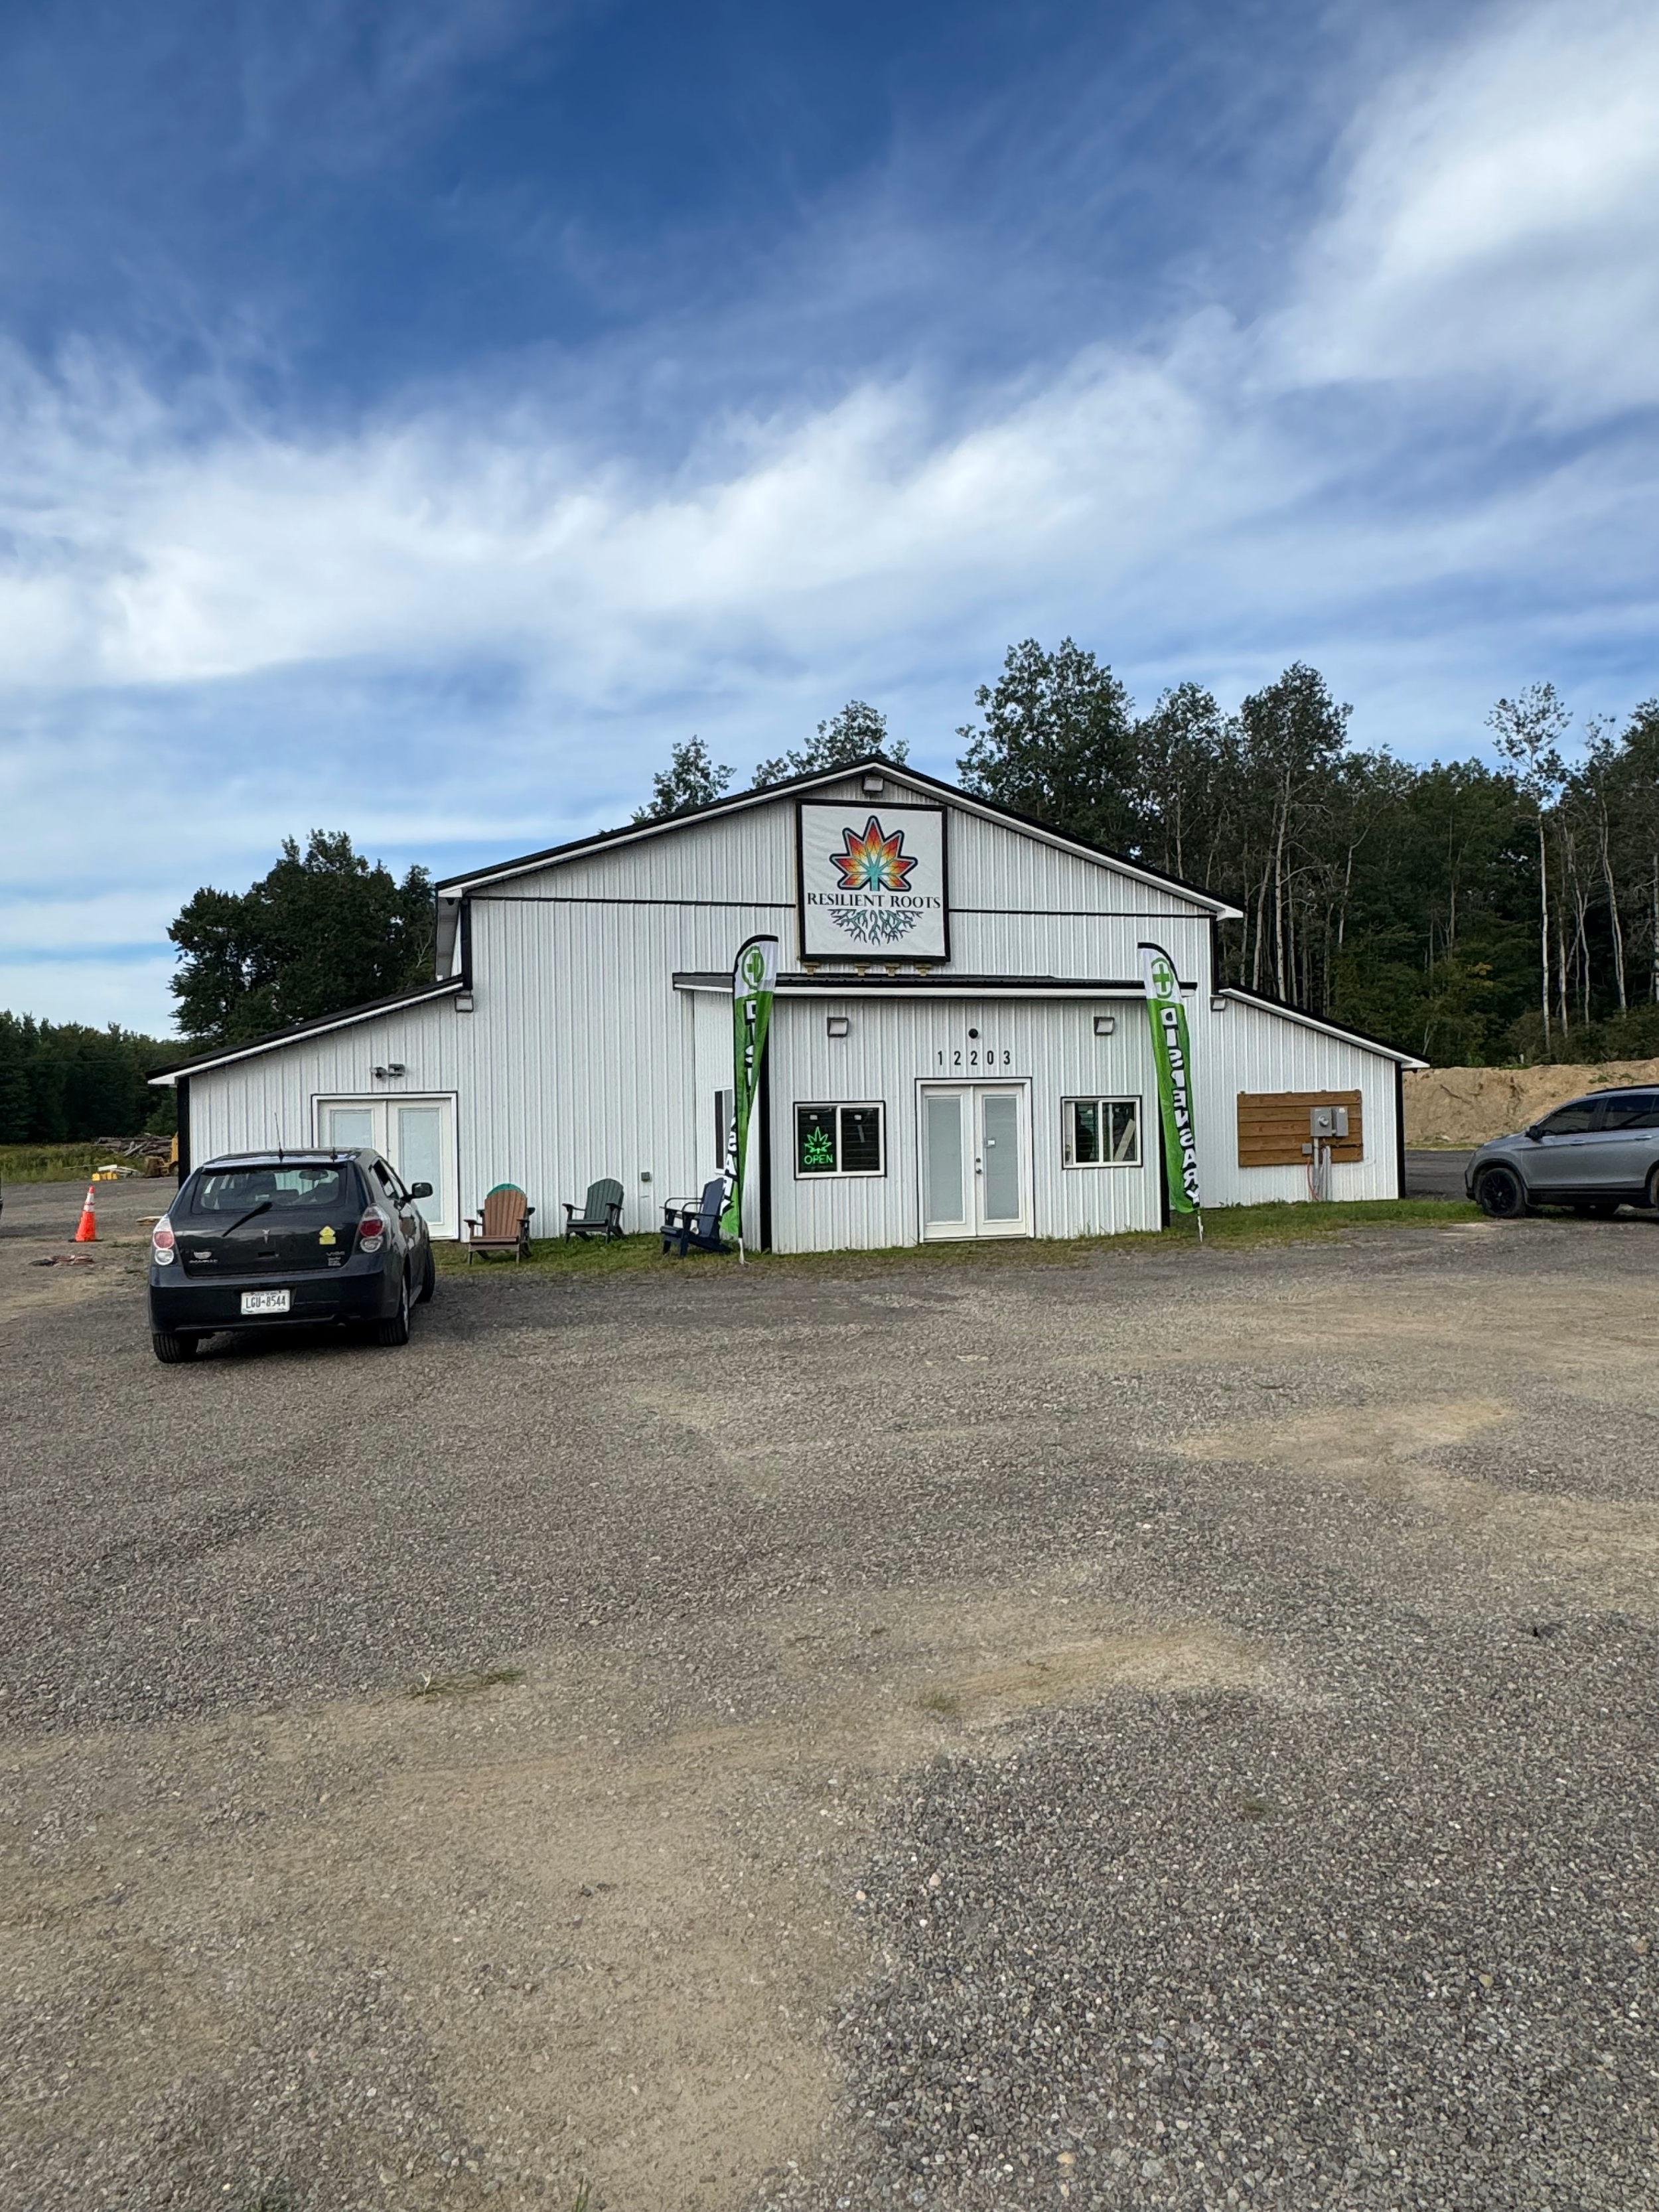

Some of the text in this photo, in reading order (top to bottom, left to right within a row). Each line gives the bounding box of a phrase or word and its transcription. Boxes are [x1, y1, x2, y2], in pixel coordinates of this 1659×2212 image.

[806, 893, 942, 909] RESILIENT ROOTS
[937, 1050, 1011, 1066] 12203
[804, 1154, 833, 1165] OPEN
